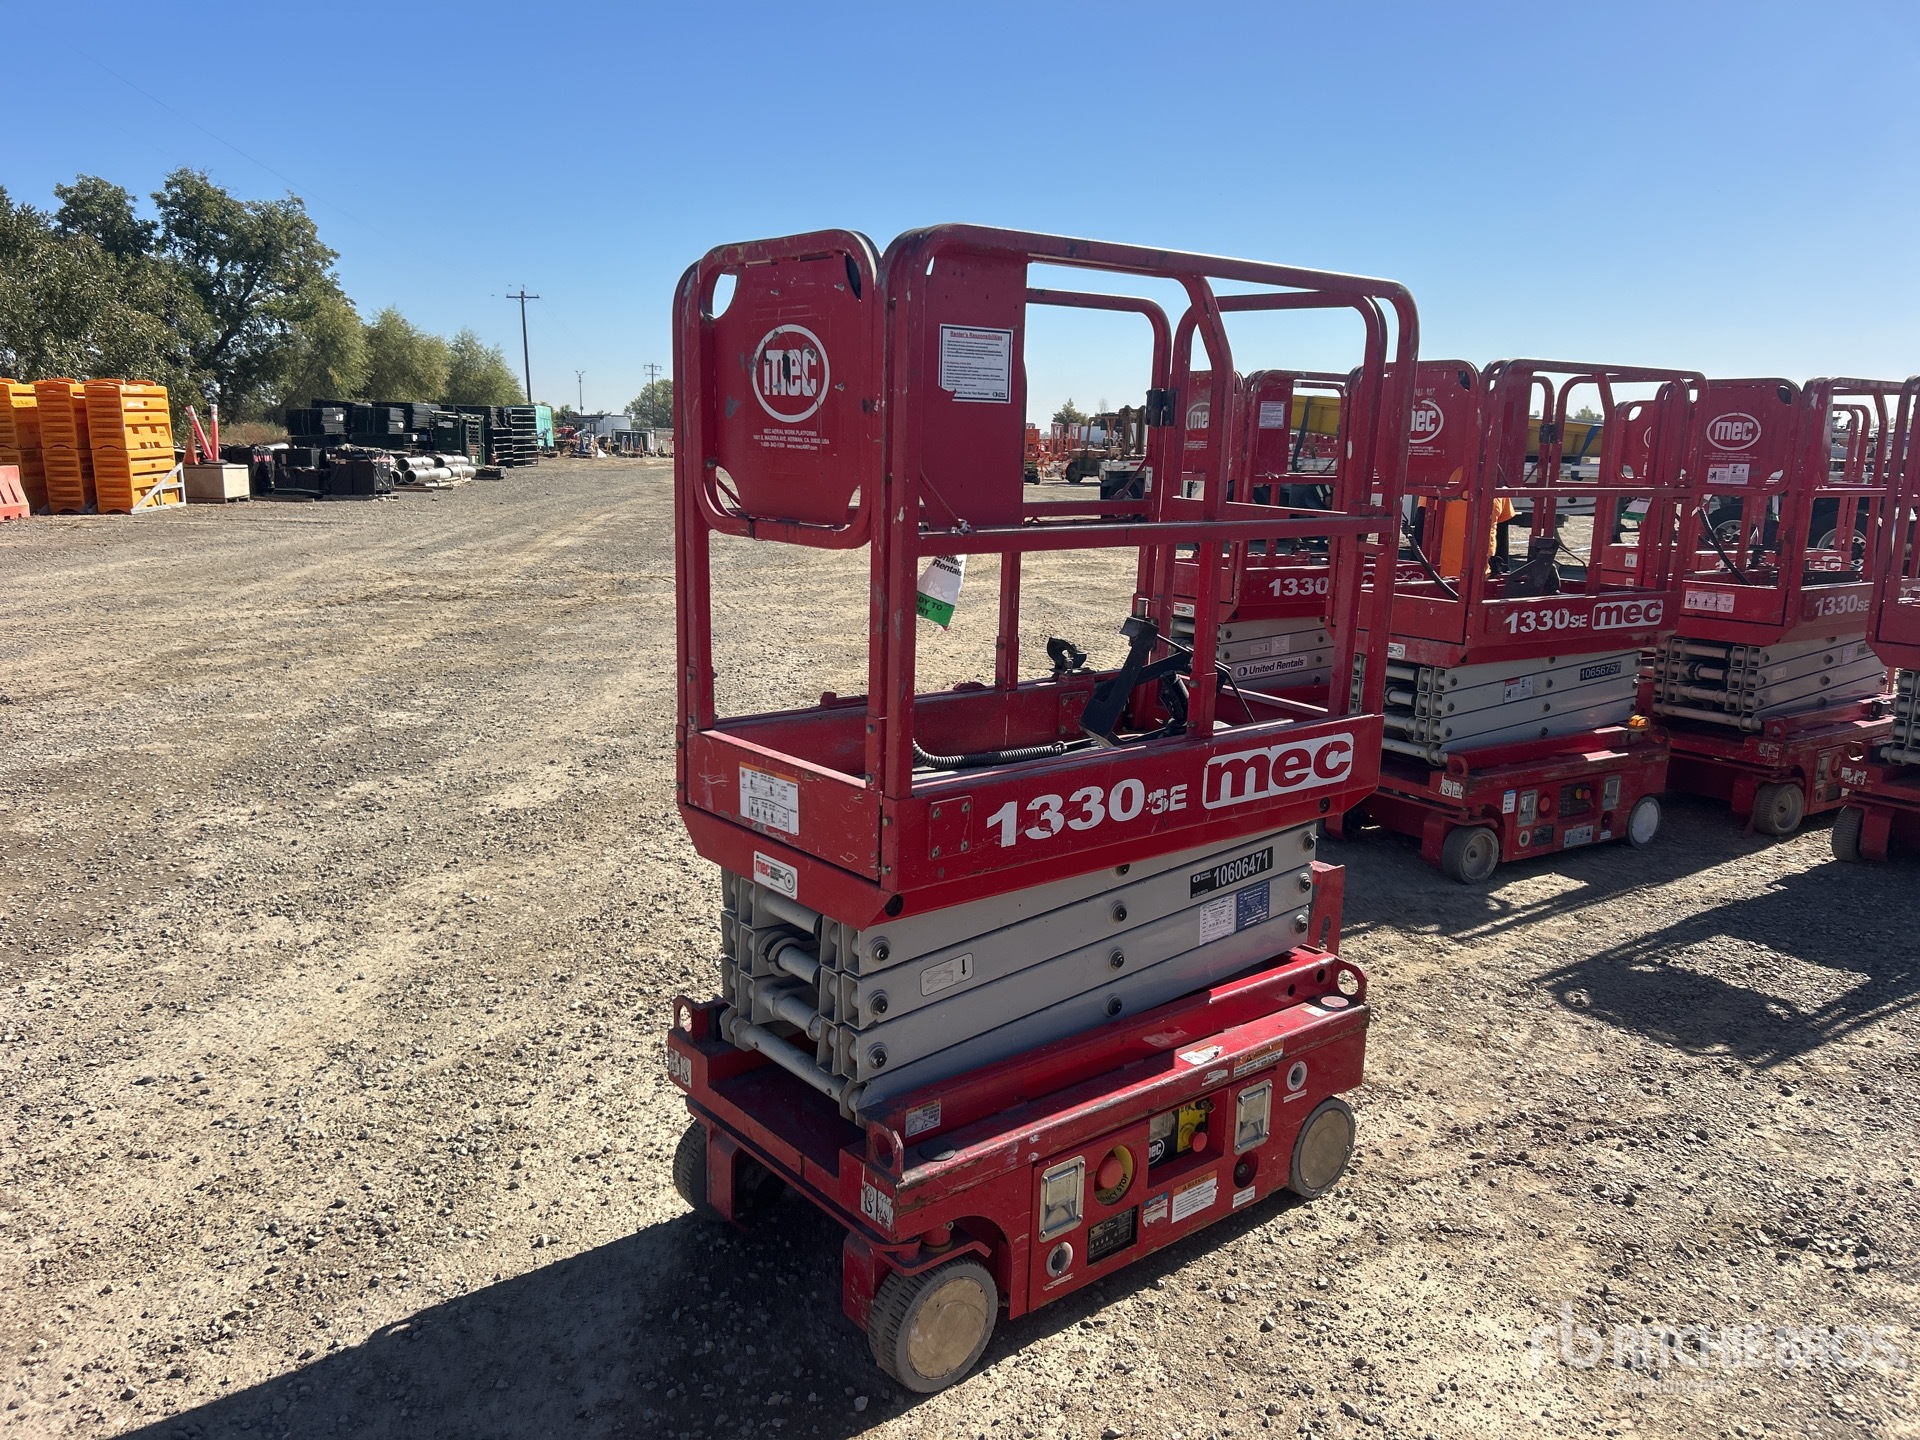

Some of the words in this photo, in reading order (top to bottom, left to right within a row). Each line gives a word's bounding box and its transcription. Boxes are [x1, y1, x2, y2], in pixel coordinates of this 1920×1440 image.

[950, 330, 968, 338] Renter's
[969, 332, 1003, 341] Responsibilities
[1190, 411, 1209, 429] me
[1714, 421, 1754, 441] mec
[932, 559, 963, 577] Rentals
[932, 601, 943, 611] TO
[1594, 602, 1662, 627] mec
[1250, 664, 1275, 675] United
[1276, 657, 1304, 671] Rentals
[1580, 662, 1621, 680] 10656757
[1205, 740, 1354, 805] mec
[1214, 849, 1268, 887] 10606471
[1117, 1173, 1129, 1193] STOP
